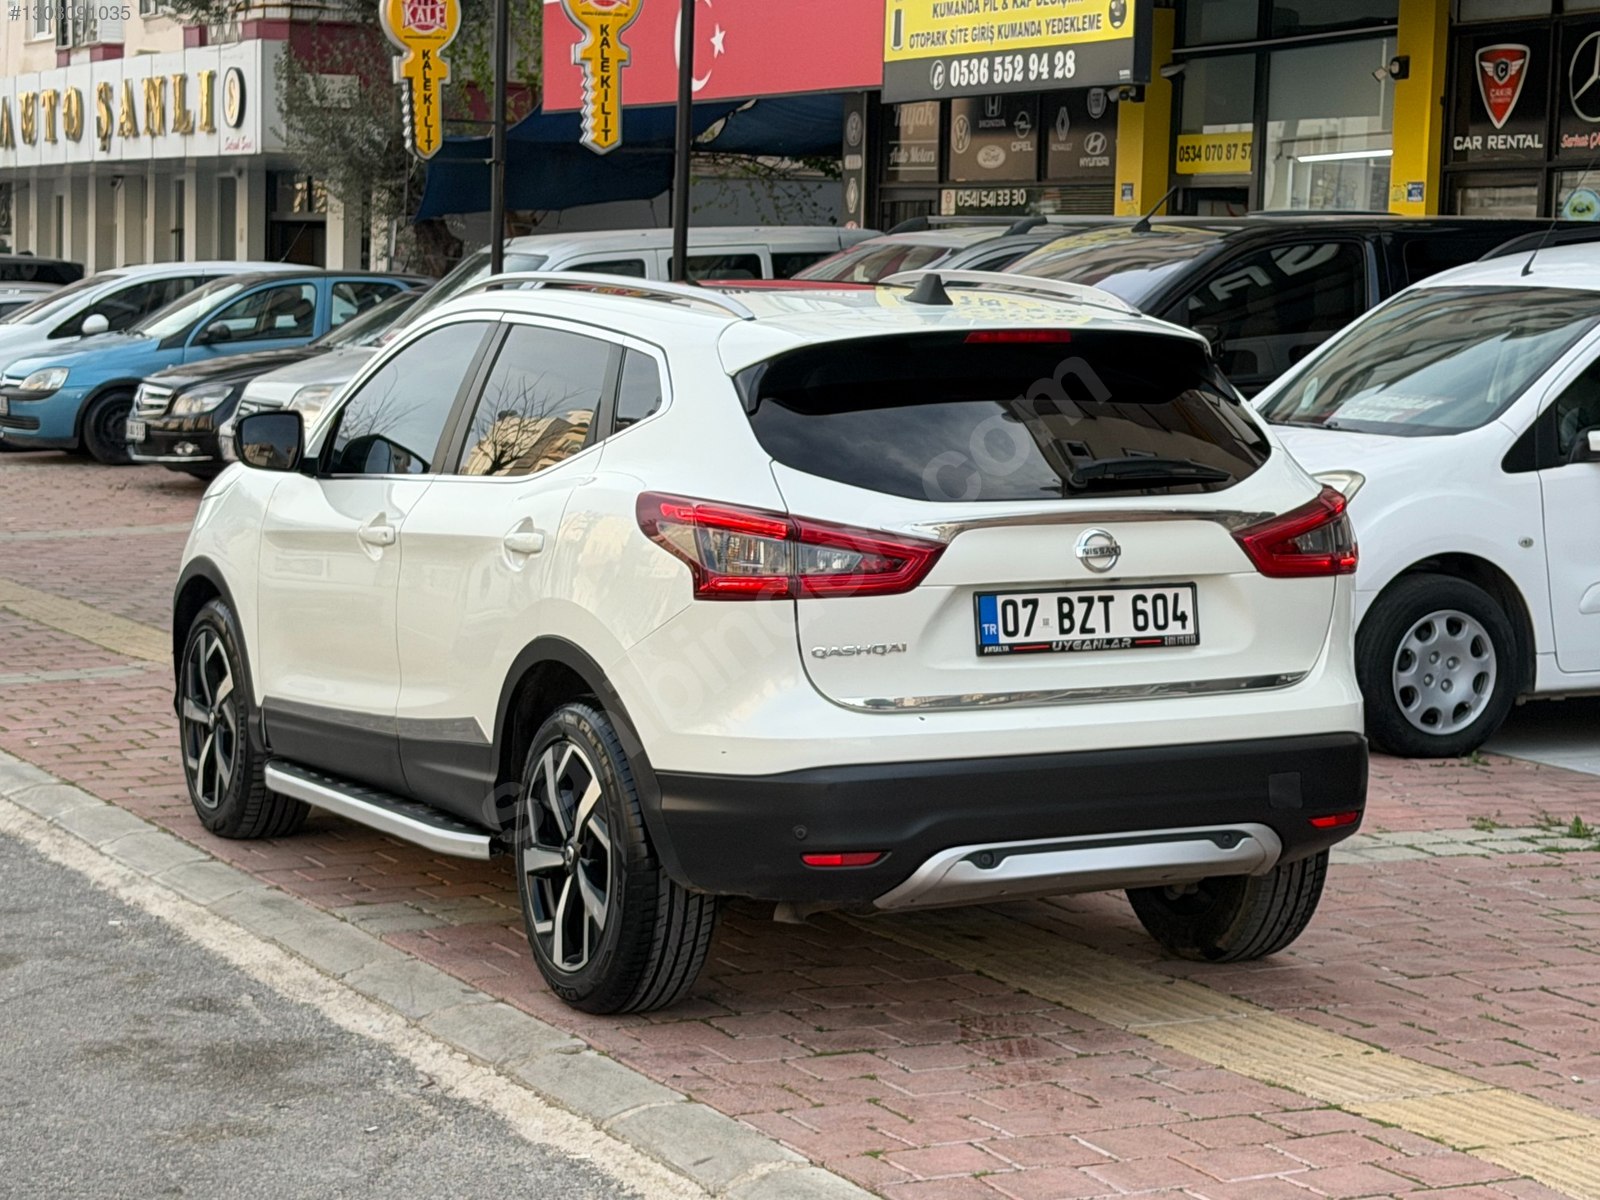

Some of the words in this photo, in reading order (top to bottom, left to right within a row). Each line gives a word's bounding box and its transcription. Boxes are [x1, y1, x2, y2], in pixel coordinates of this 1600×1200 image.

[403, 4, 447, 28] KALE
[932, 0, 980, 18] KUMANDA
[909, 30, 948, 49] OTOPARK
[950, 26, 969, 45] SİTE
[971, 22, 995, 44] GİRİŞ
[997, 20, 1042, 40] KUMANDA
[1045, 13, 1102, 35] YEDEKLEME
[950, 57, 989, 87] 0536
[993, 53, 1024, 84] 552
[1028, 52, 1049, 81] 94
[1054, 49, 1076, 79] 28
[0, 86, 84, 151] AUTO
[96, 70, 217, 154] ŞANLI
[1011, 141, 1034, 152] OPEL
[1453, 136, 1482, 150] CAR
[1487, 134, 1543, 149] RENTAL
[1179, 145, 1202, 162] 0534
[1205, 144, 1223, 161] 070
[1226, 143, 1238, 160] 87
[1241, 142, 1252, 159] 57
[1082, 546, 1117, 556] NISSAN
[1001, 597, 1040, 638] 07
[1057, 594, 1115, 636] BZT
[1131, 592, 1188, 632] 604
[983, 623, 997, 635] TR
[811, 642, 907, 660] QASHQAI
